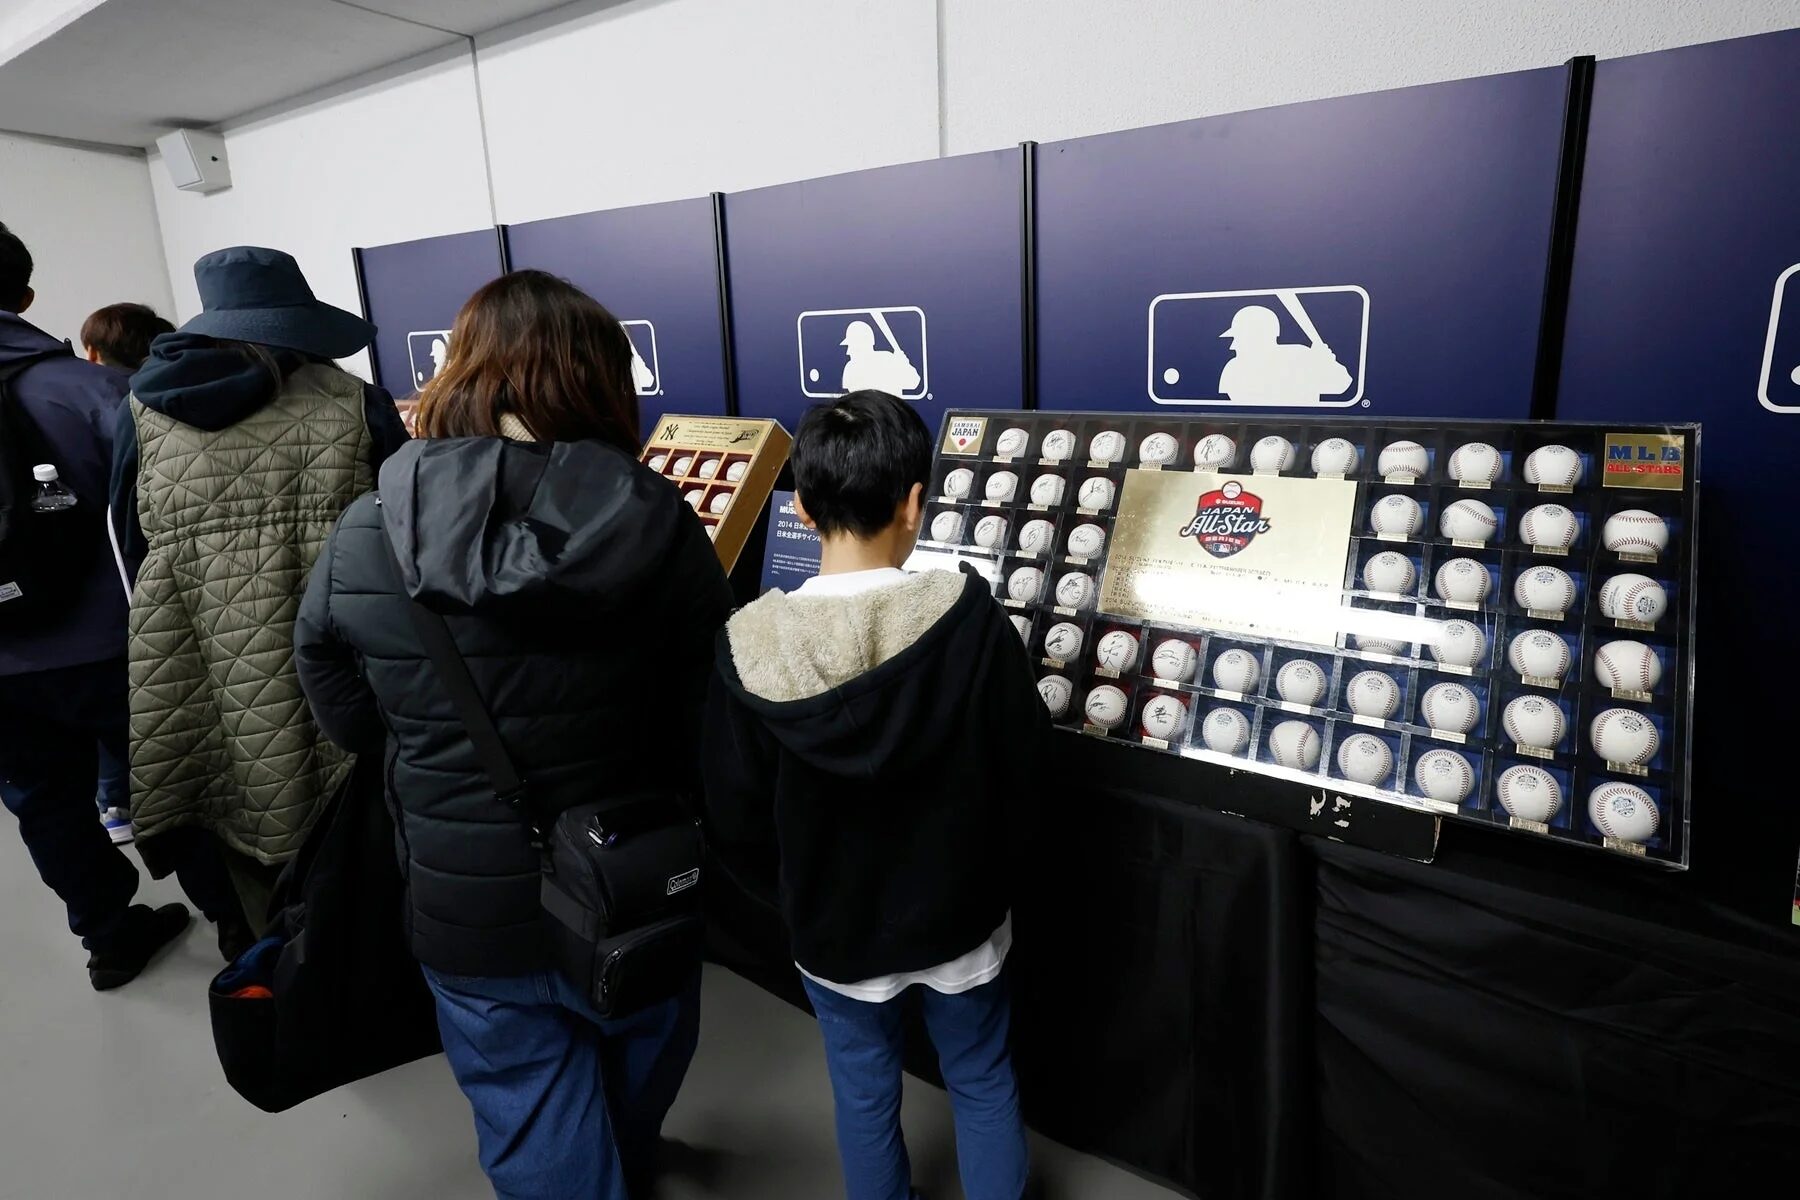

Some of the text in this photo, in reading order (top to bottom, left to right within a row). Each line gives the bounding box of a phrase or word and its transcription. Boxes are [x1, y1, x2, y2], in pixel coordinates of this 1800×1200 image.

[952, 428, 978, 436] JAPAN
[1202, 506, 1255, 515] JAPAN
[777, 520, 792, 528] 2014
[1180, 514, 1271, 537] All-Star
[1205, 536, 1242, 545] SERIES
